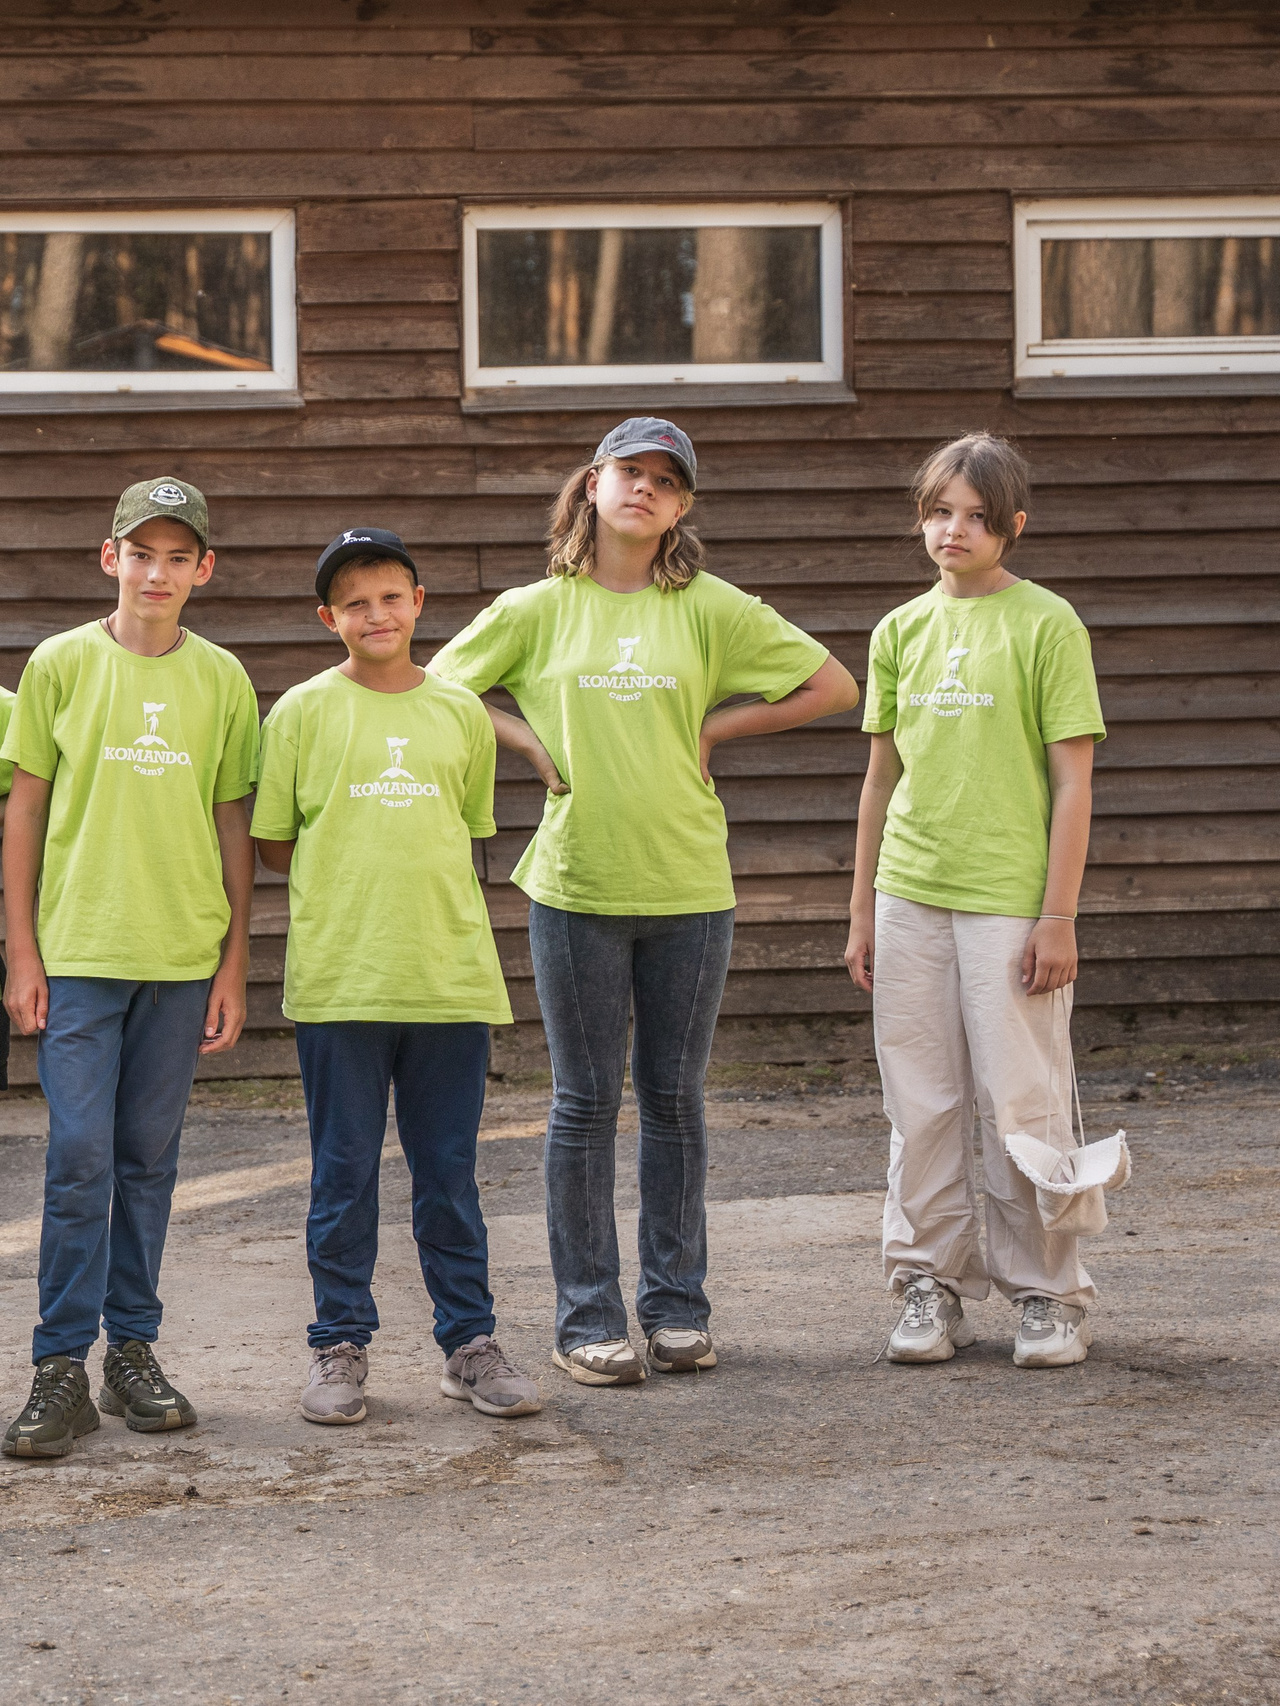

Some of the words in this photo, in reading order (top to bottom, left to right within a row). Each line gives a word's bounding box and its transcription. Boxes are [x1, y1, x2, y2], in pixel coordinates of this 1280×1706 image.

[577, 674, 677, 690] KOMANDOR
[608, 691, 642, 702] camp
[909, 691, 995, 707] KOMANDOR
[932, 707, 963, 717] camp
[104, 746, 193, 766] KOMANDO
[132, 764, 165, 776] camp
[380, 797, 413, 808] camp
